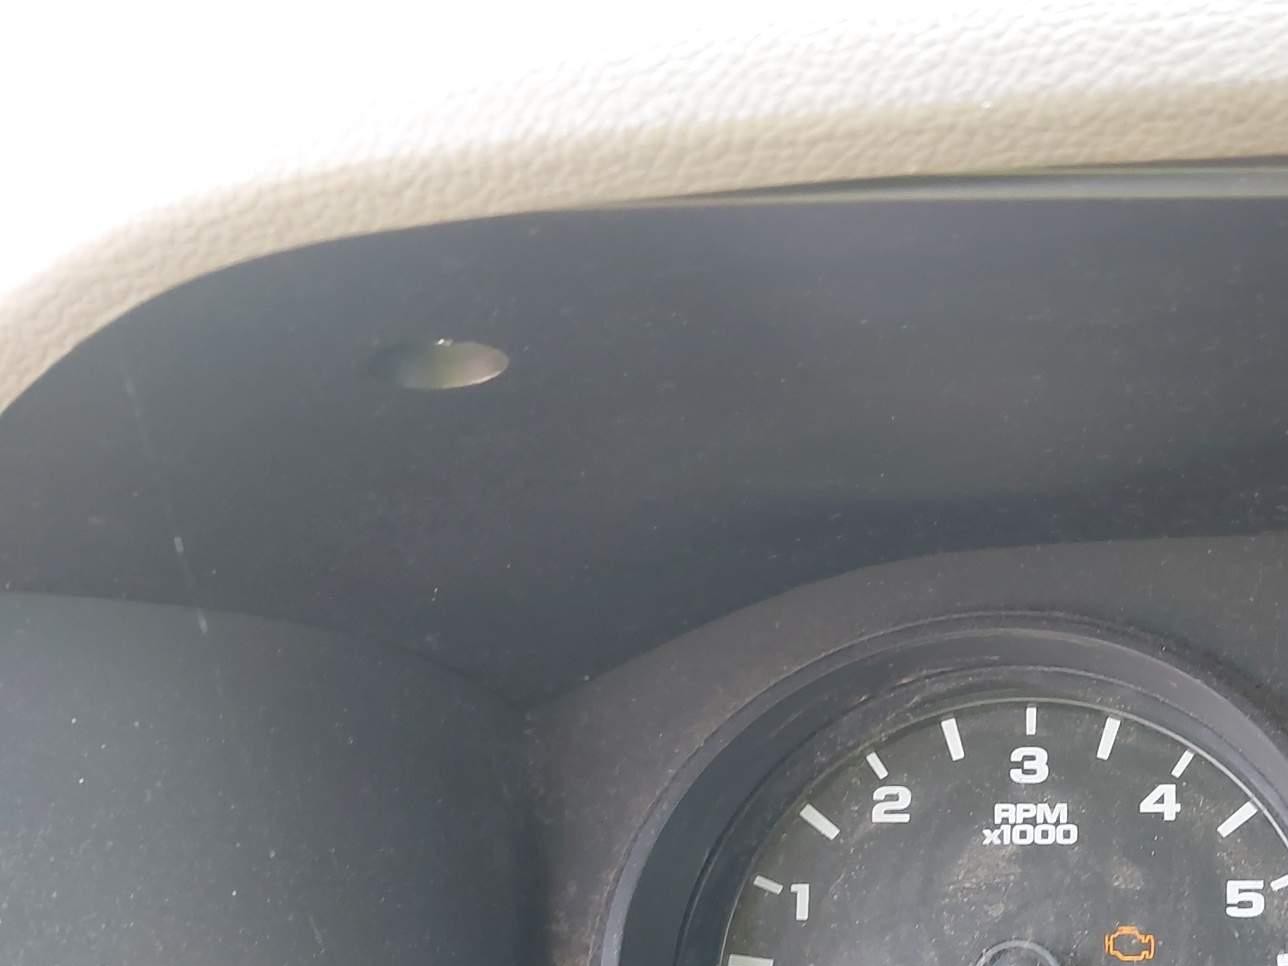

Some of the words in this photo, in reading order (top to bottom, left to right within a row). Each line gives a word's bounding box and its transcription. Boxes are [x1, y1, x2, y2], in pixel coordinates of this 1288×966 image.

[1009, 746, 1049, 783] 3
[871, 785, 912, 823] 2
[994, 803, 1068, 824] RPM
[1139, 784, 1181, 821] 4
[982, 823, 1078, 845] x1000
[790, 883, 810, 921] 1
[1225, 879, 1265, 917] 5
